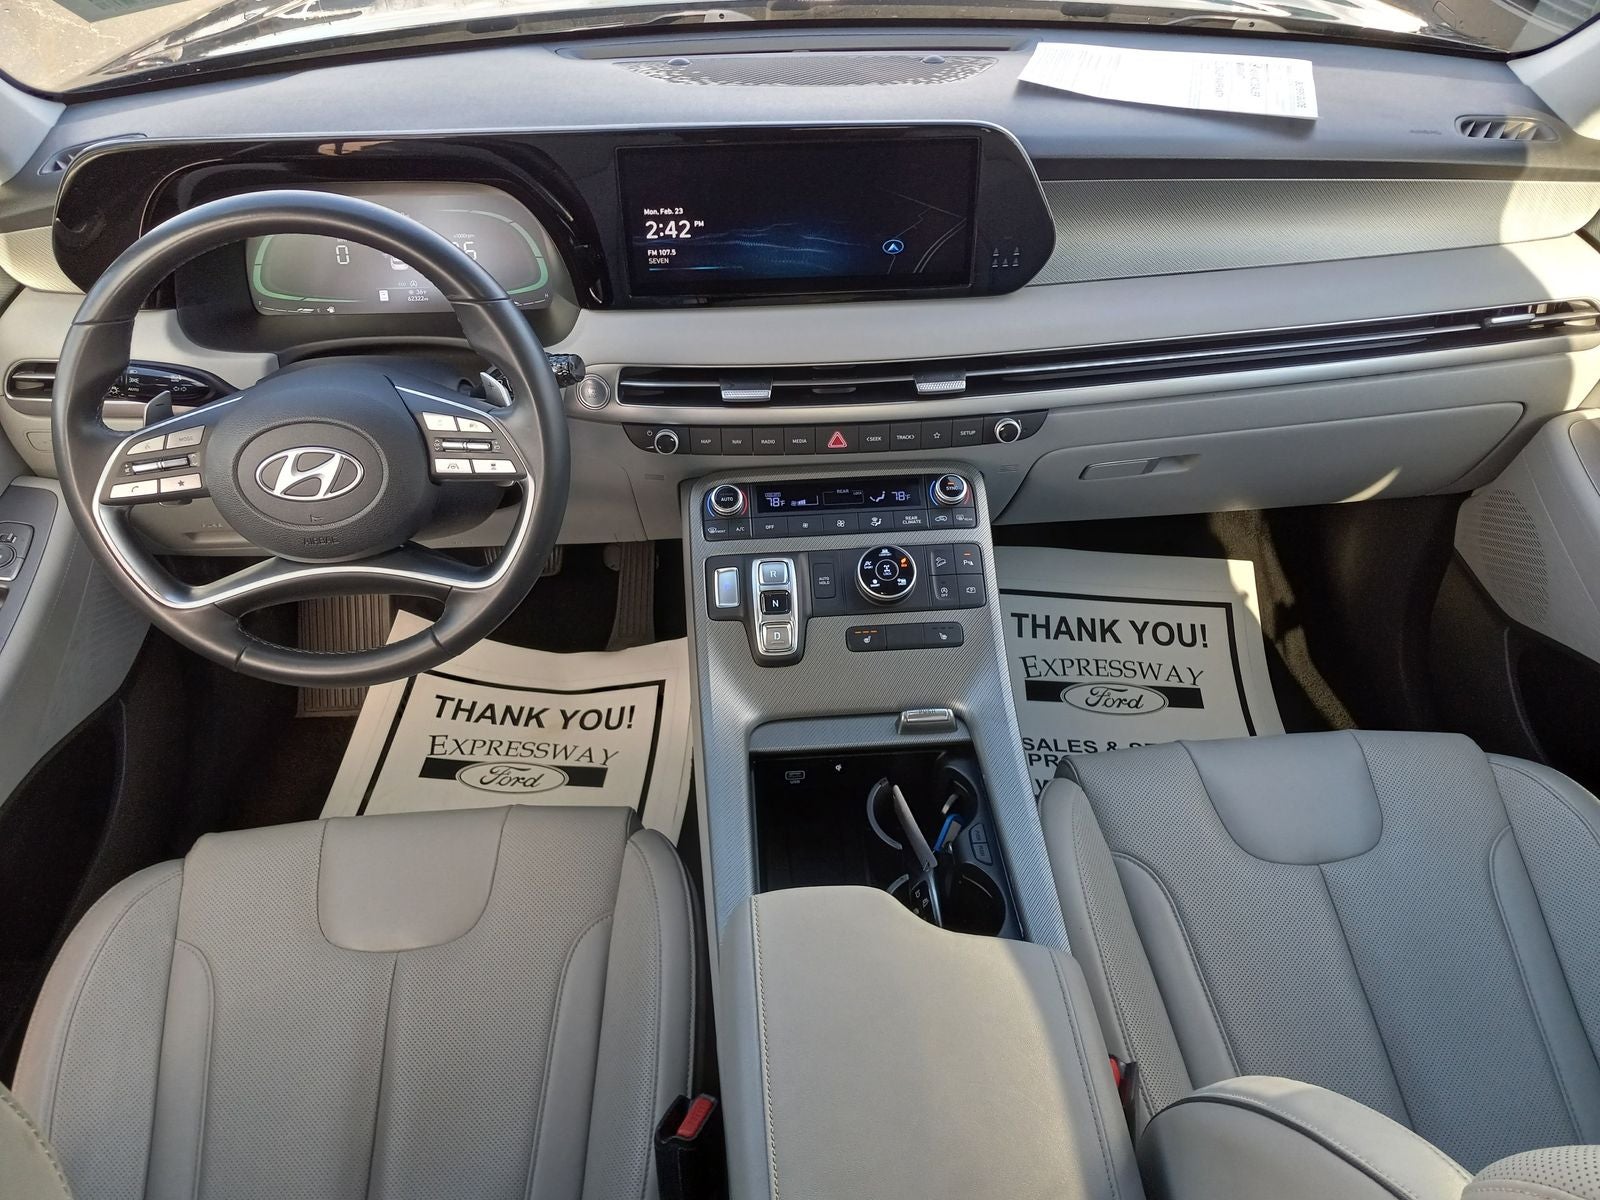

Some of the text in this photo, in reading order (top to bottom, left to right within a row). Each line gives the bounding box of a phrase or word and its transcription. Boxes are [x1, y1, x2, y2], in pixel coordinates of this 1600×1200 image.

[645, 220, 691, 239] 2:42
[336, 244, 350, 265] 0
[659, 248, 677, 256] 107.5
[774, 632, 781, 640] D
[1010, 612, 1208, 648] THANK YOU!
[1019, 655, 1204, 687] EXPRESSWAY
[1085, 686, 1145, 710] Ford
[435, 694, 635, 731] THANK YOU!
[428, 735, 619, 766] EXPRESSWAY
[1022, 737, 1098, 754] SALES
[479, 765, 545, 788] Ford
